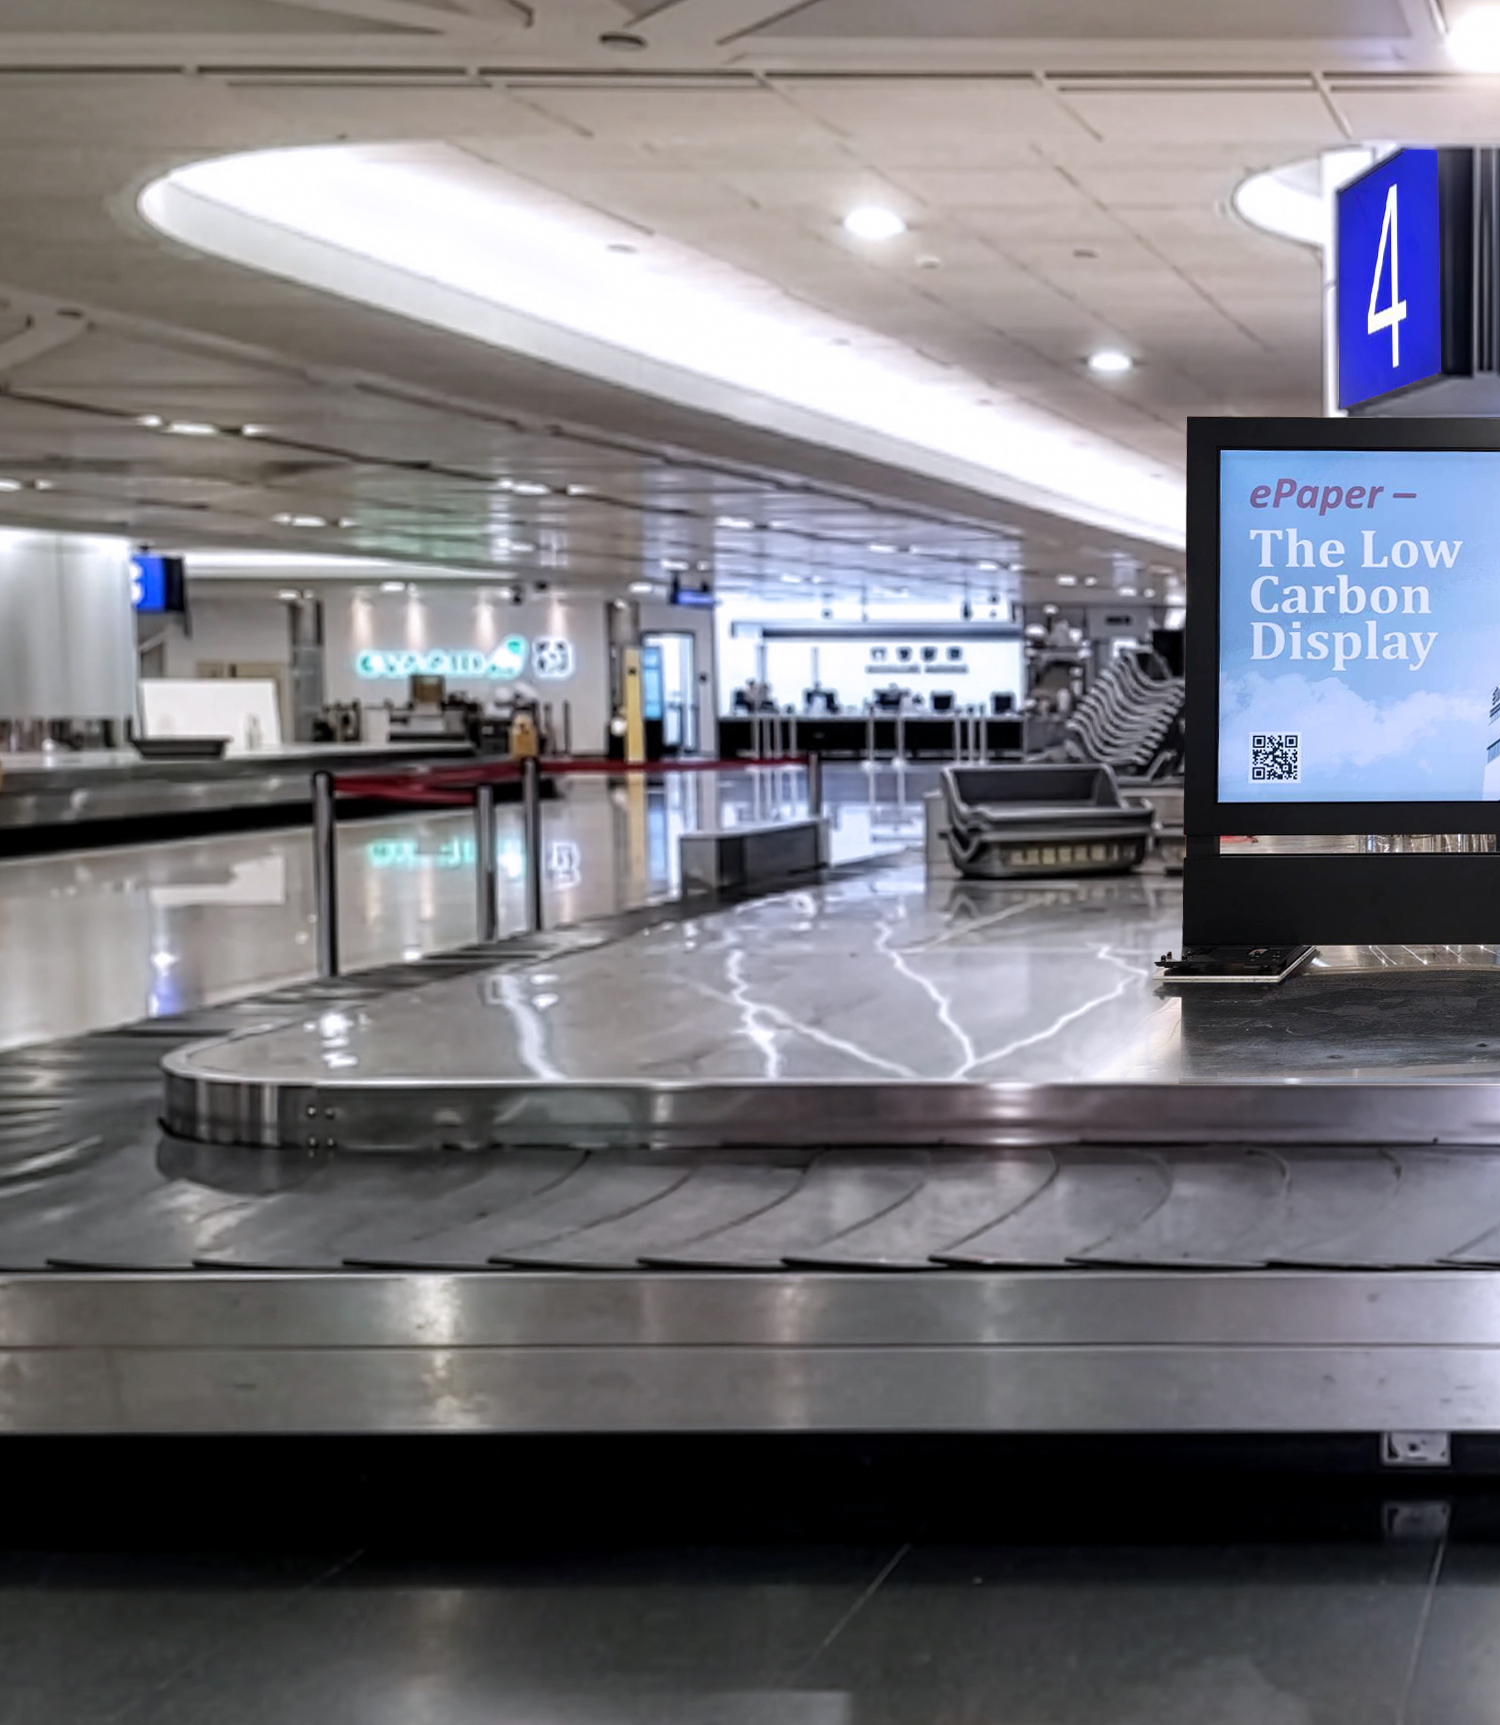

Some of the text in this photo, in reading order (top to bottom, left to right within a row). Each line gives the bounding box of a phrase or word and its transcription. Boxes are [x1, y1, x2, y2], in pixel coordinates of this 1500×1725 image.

[1367, 183, 1407, 368] 4
[1250, 478, 1385, 516] ePaper
[1250, 528, 1463, 568] The Low
[1250, 574, 1431, 614] Carbon
[1250, 620, 1438, 671] Display
